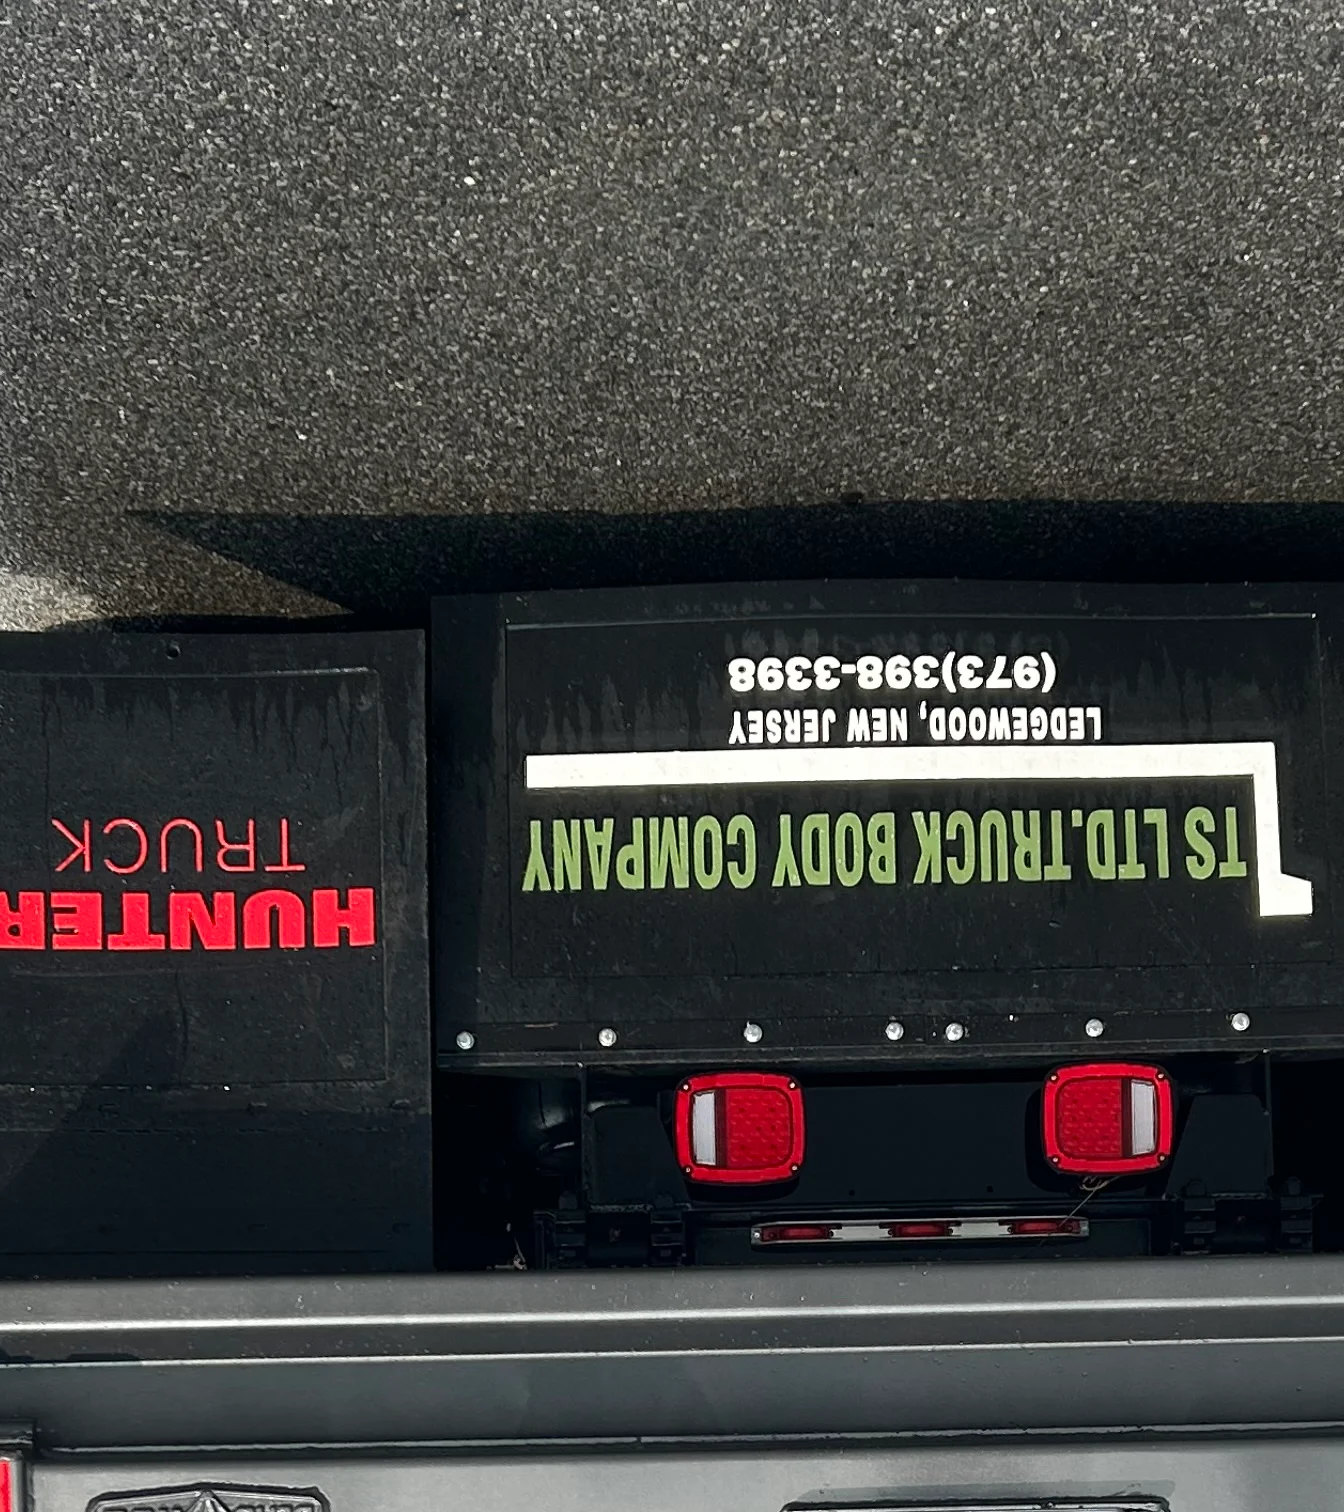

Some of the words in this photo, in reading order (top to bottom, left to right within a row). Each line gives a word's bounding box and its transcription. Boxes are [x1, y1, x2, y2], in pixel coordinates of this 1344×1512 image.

[727, 649, 1056, 692] (973)398-3398
[727, 706, 836, 744] JERSEY
[845, 704, 908, 741] NEW
[917, 699, 1101, 740] LEDGEWOOD,
[50, 816, 304, 872] TRUCK
[520, 812, 755, 892] COMPANY
[770, 810, 889, 887] BODY
[1182, 804, 1246, 876] TS
